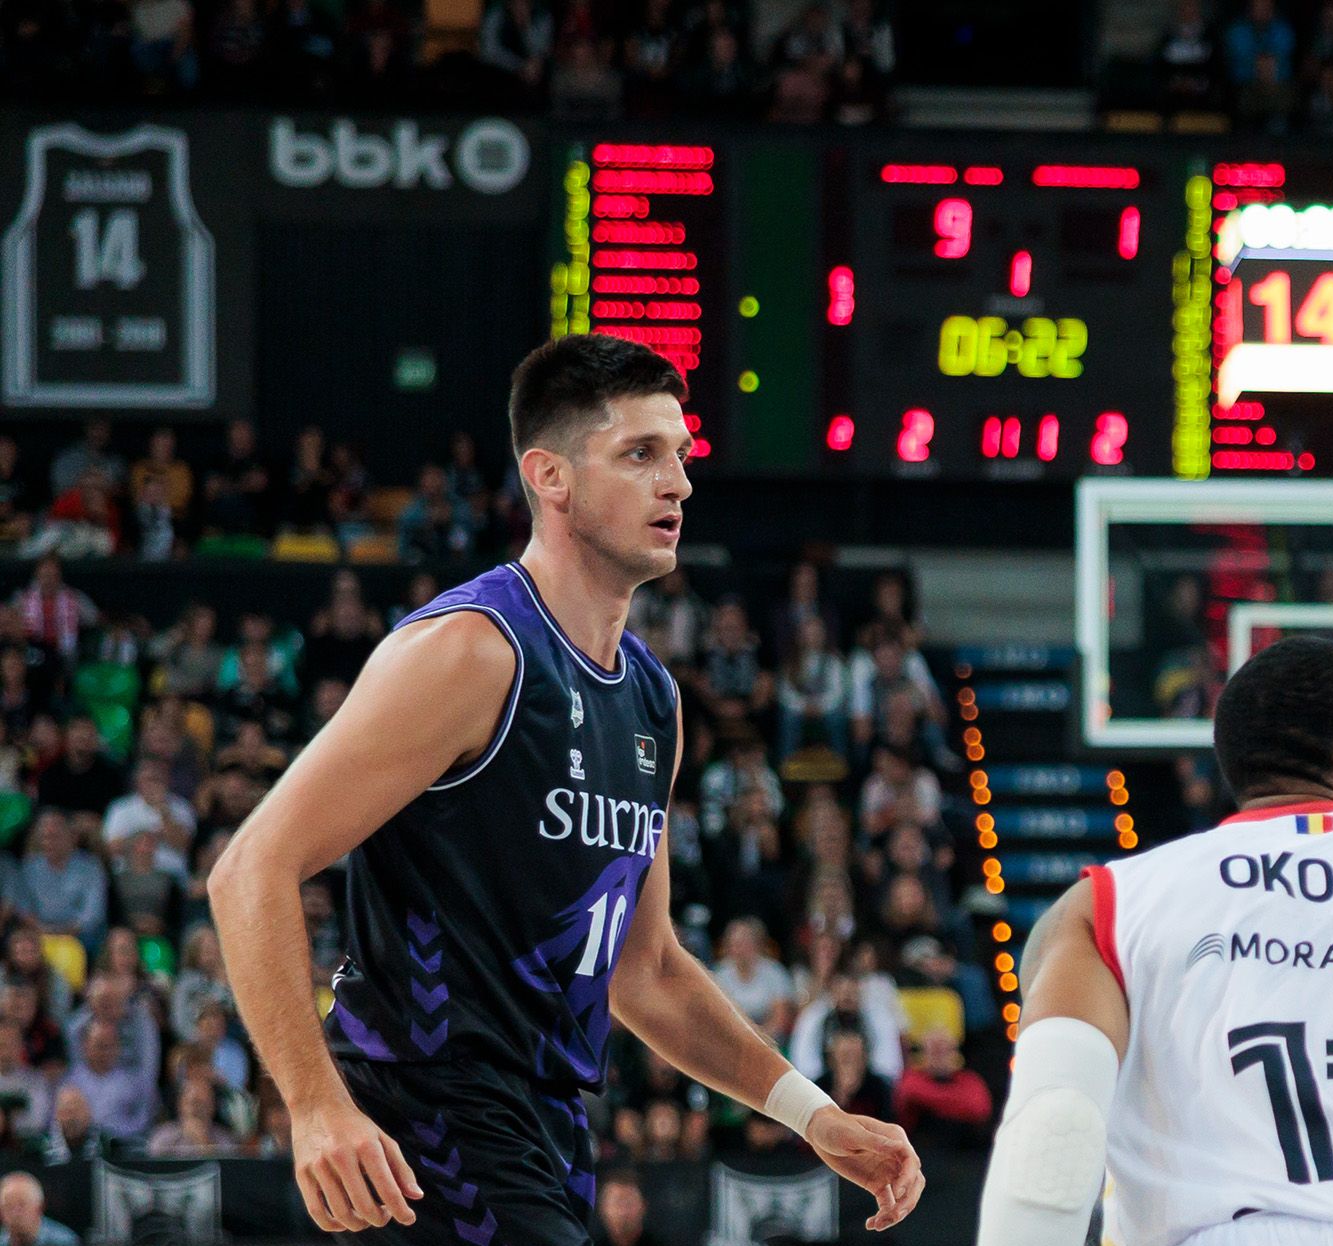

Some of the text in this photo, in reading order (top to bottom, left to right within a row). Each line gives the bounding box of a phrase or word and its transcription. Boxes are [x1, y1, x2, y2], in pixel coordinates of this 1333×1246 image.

[70, 207, 146, 290] 14
[934, 198, 973, 259] 9
[938, 315, 1089, 379] 06:22
[897, 407, 935, 462] 2
[1091, 411, 1129, 465] 2
